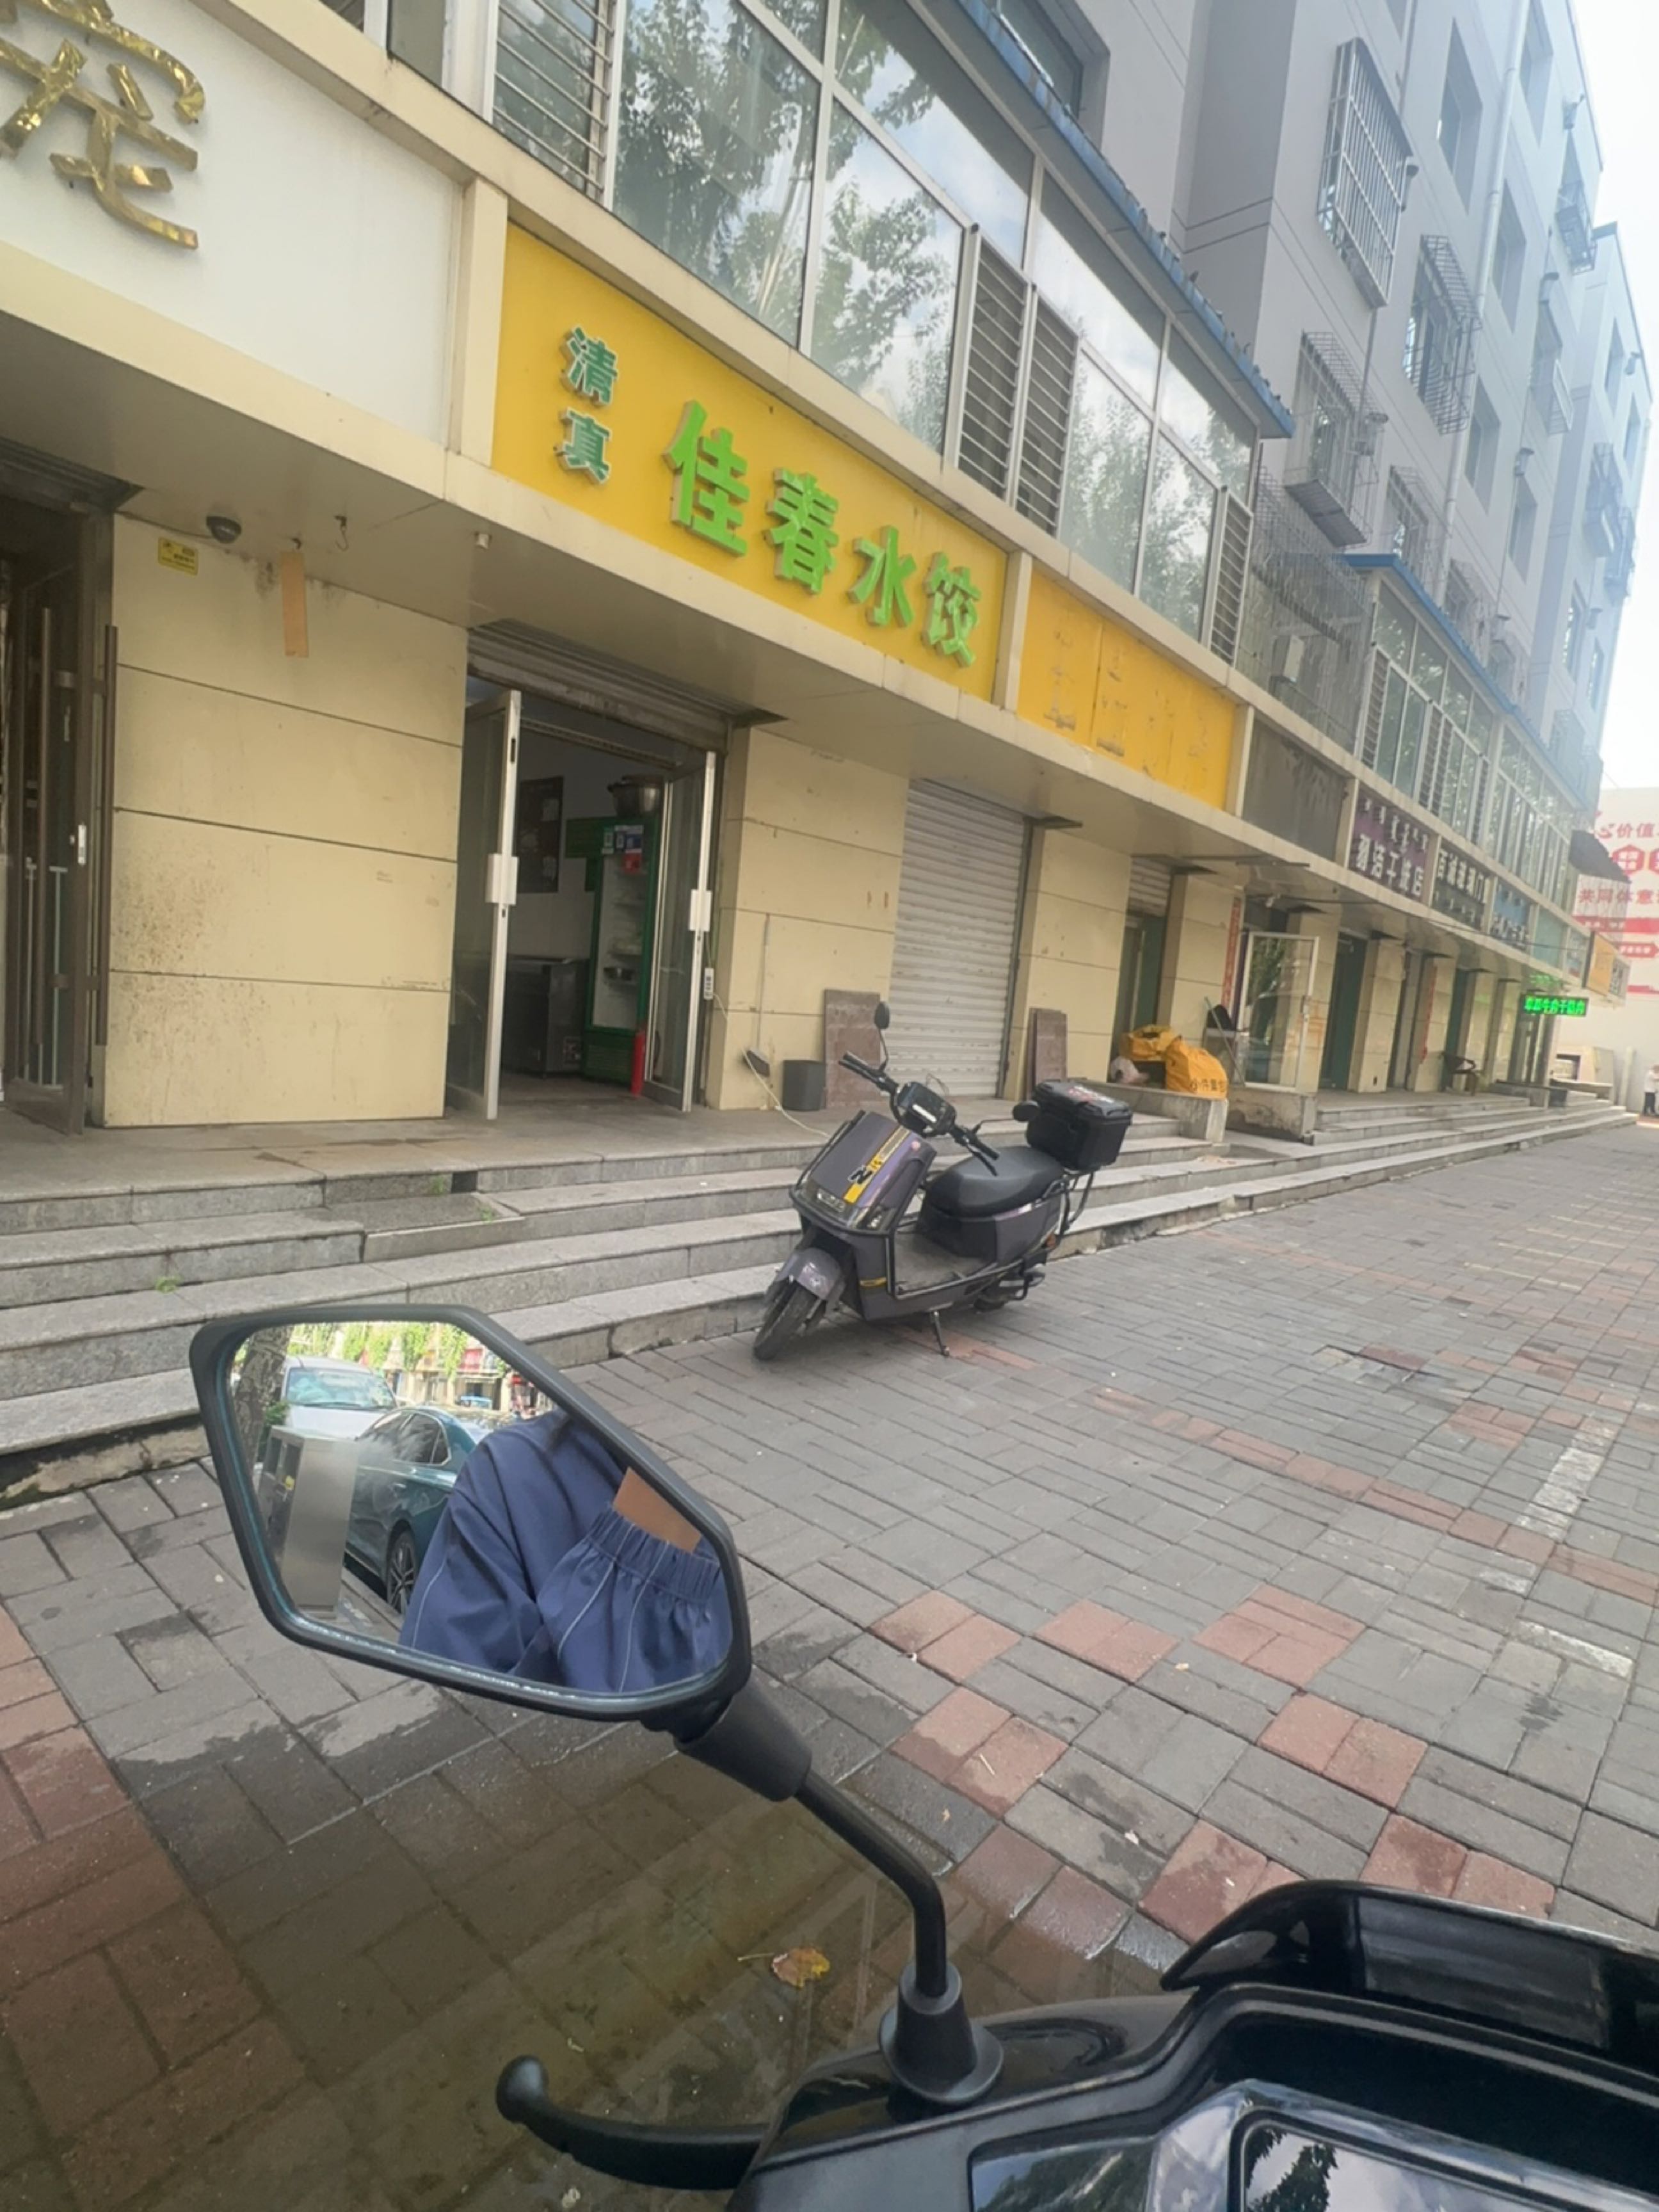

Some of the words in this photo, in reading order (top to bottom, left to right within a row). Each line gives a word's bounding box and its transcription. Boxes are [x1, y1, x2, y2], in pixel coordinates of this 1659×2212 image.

[557, 326, 619, 485] 清真
[663, 399, 982, 668] 佳春水饺
[1596, 823, 1659, 838] 心价值
[1578, 888, 1659, 904] 共同体意
